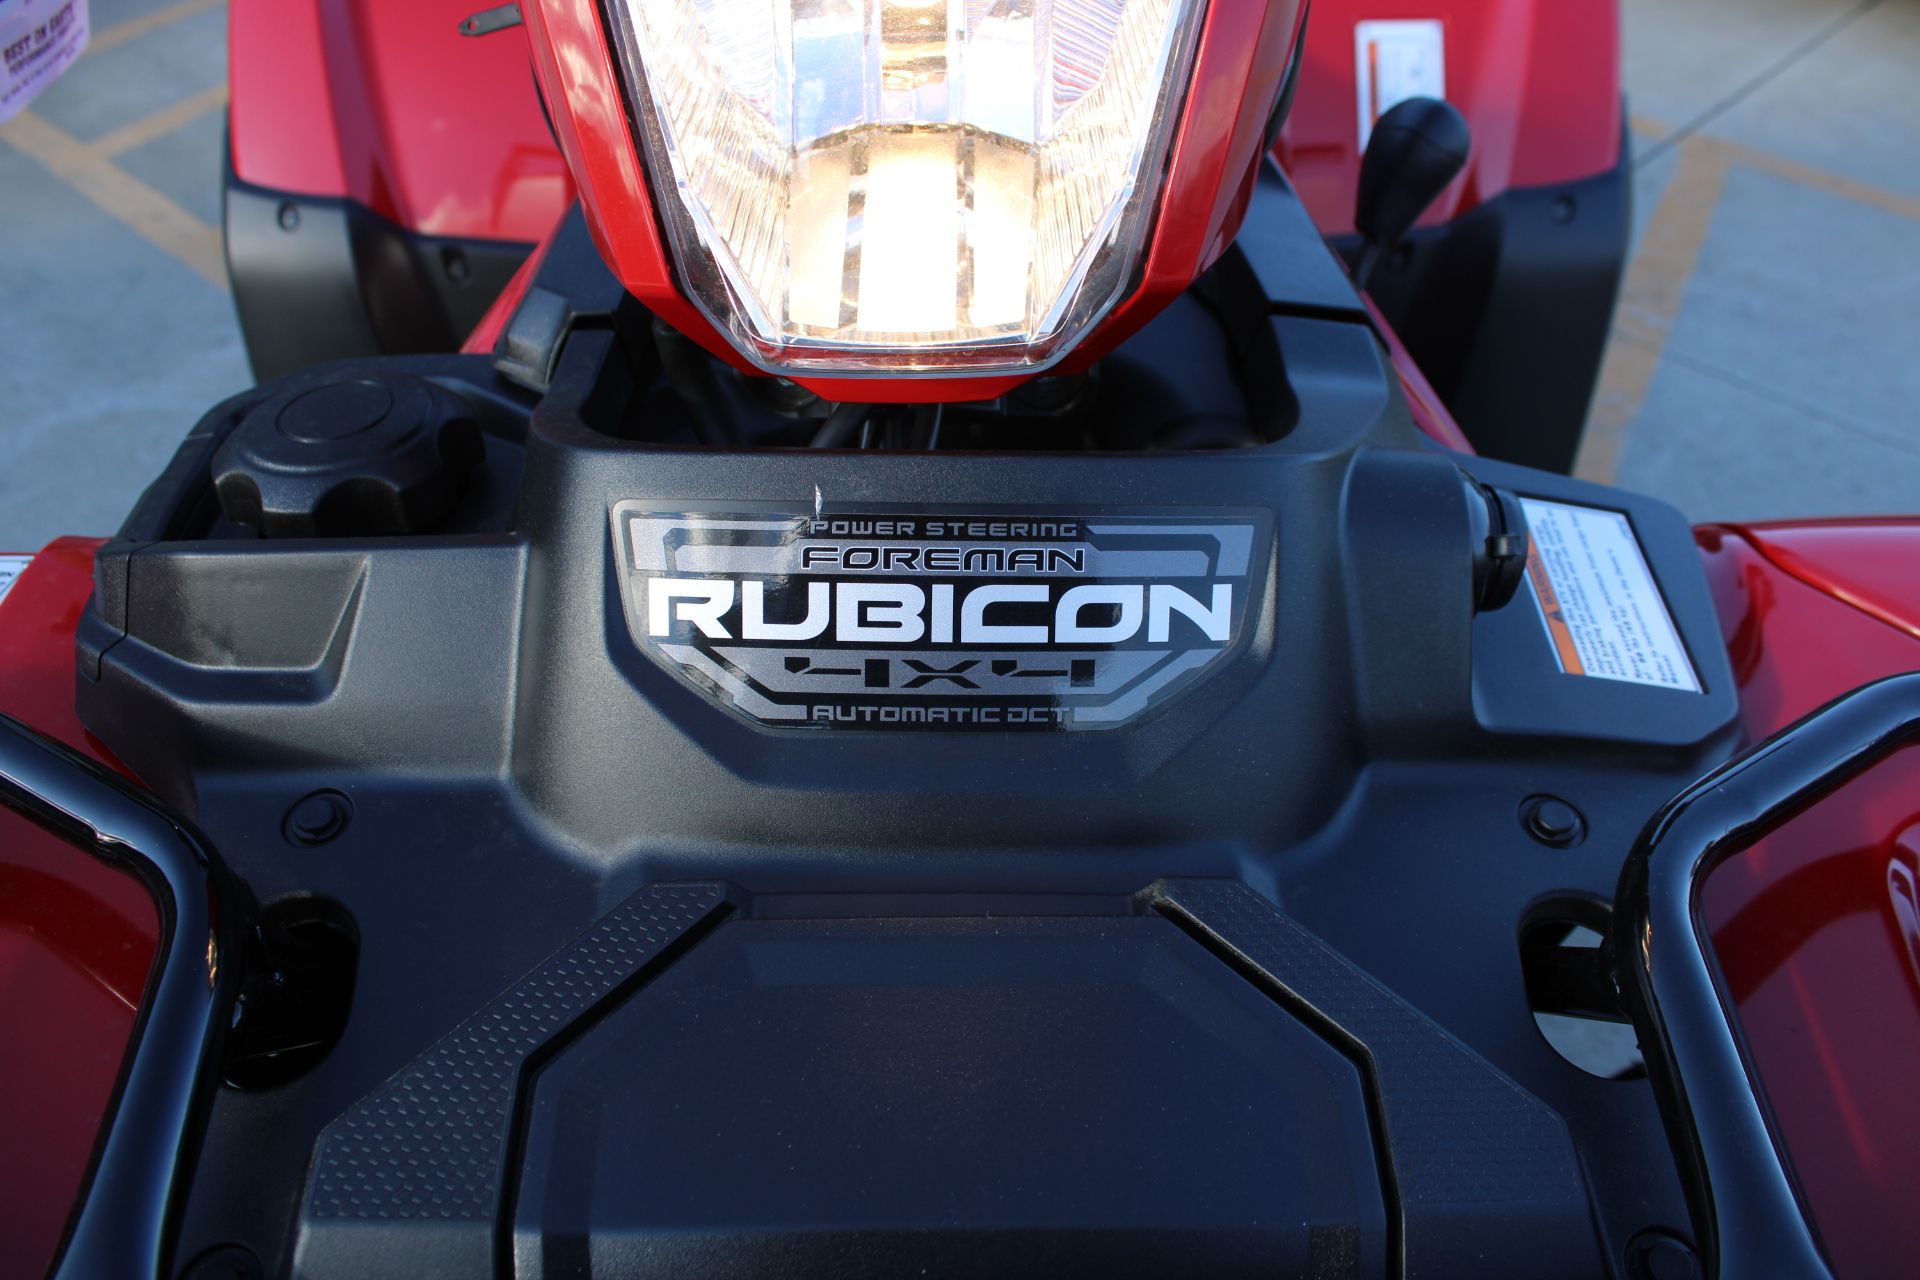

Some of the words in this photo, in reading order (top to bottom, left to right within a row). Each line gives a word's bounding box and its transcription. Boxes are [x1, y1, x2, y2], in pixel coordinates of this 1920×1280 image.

[810, 520, 916, 536] POWER
[926, 522, 1078, 537] STEERING
[801, 546, 1086, 573] FOREMAN
[647, 577, 1232, 643] RUBICON
[812, 705, 1001, 723] AUTOMATIC
[1007, 707, 1069, 723] DCT
